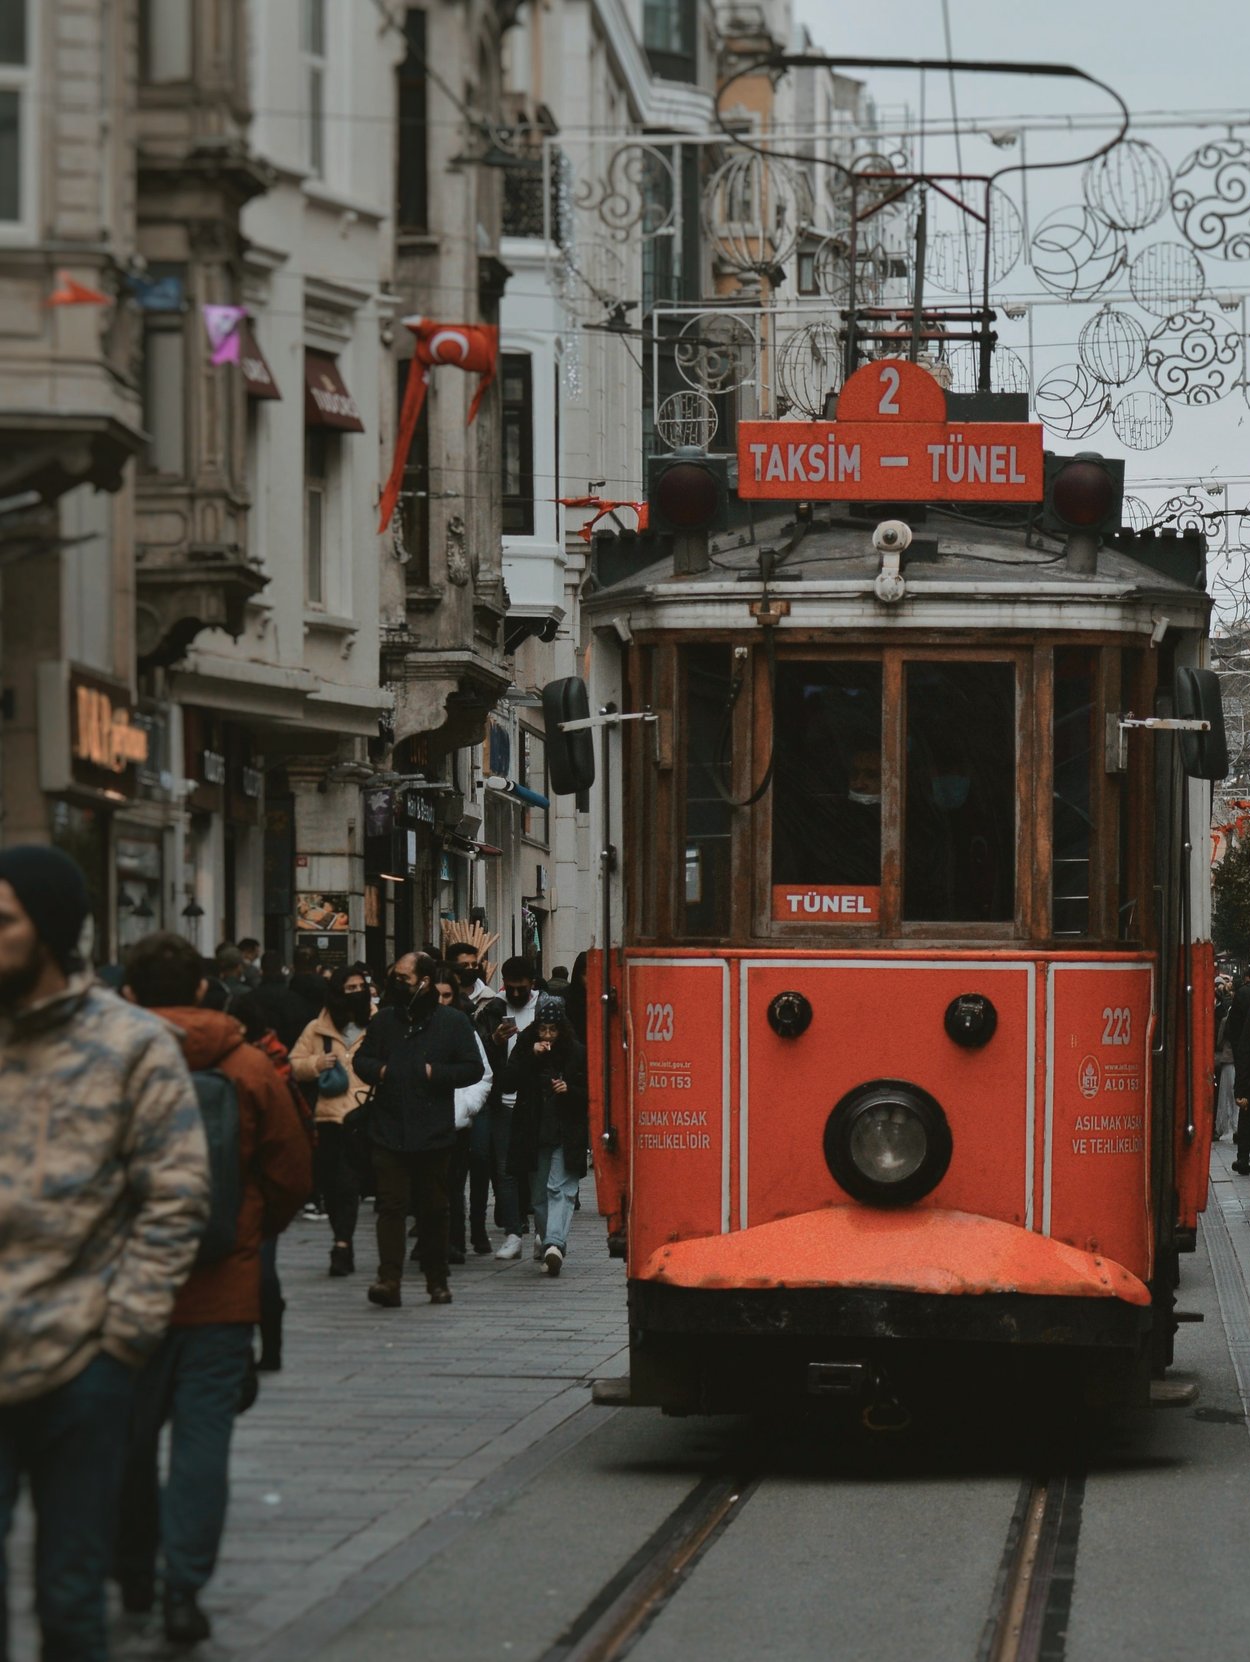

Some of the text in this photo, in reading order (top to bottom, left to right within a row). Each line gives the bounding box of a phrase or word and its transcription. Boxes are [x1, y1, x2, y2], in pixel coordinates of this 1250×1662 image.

[878, 366, 900, 415] 2
[750, 433, 861, 482] TAKSİM
[928, 434, 1026, 484] TÜNEL
[786, 891, 872, 913] TÜNEL
[646, 1003, 674, 1042] 223
[1102, 1007, 1131, 1046] 223
[649, 1076, 668, 1088] ALO
[670, 1076, 692, 1089] 153
[1104, 1079, 1125, 1091] ALO
[671, 1111, 707, 1126] YASAK
[1075, 1115, 1122, 1131] ASILMAK
[1072, 1139, 1087, 1154] VE
